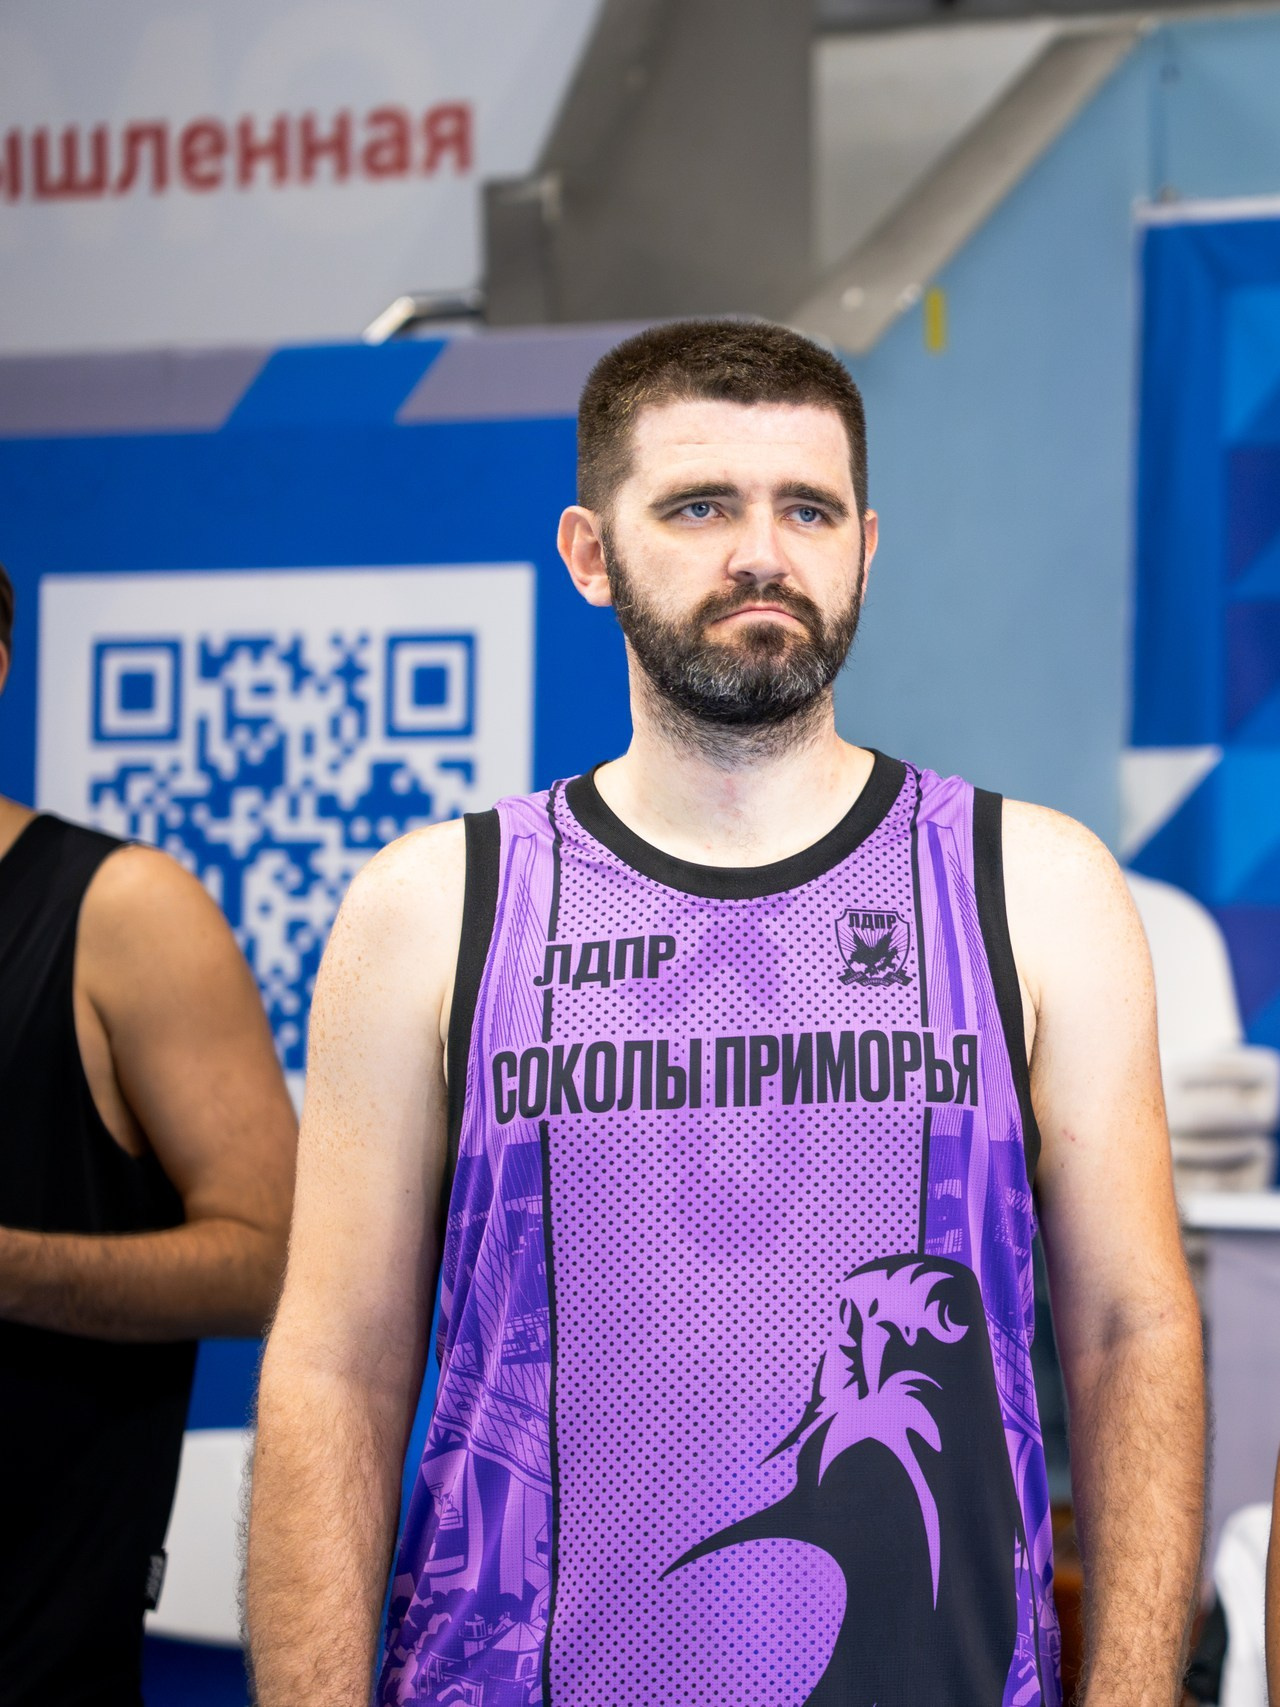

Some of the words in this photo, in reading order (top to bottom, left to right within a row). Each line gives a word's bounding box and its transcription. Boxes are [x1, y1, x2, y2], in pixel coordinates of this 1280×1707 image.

[847, 912, 897, 931] ЛДПР
[533, 935, 676, 990] ЛДПР
[492, 1037, 702, 1125] СОКОЛЫ
[715, 1029, 979, 1108] ПРИМОРЬЯ
